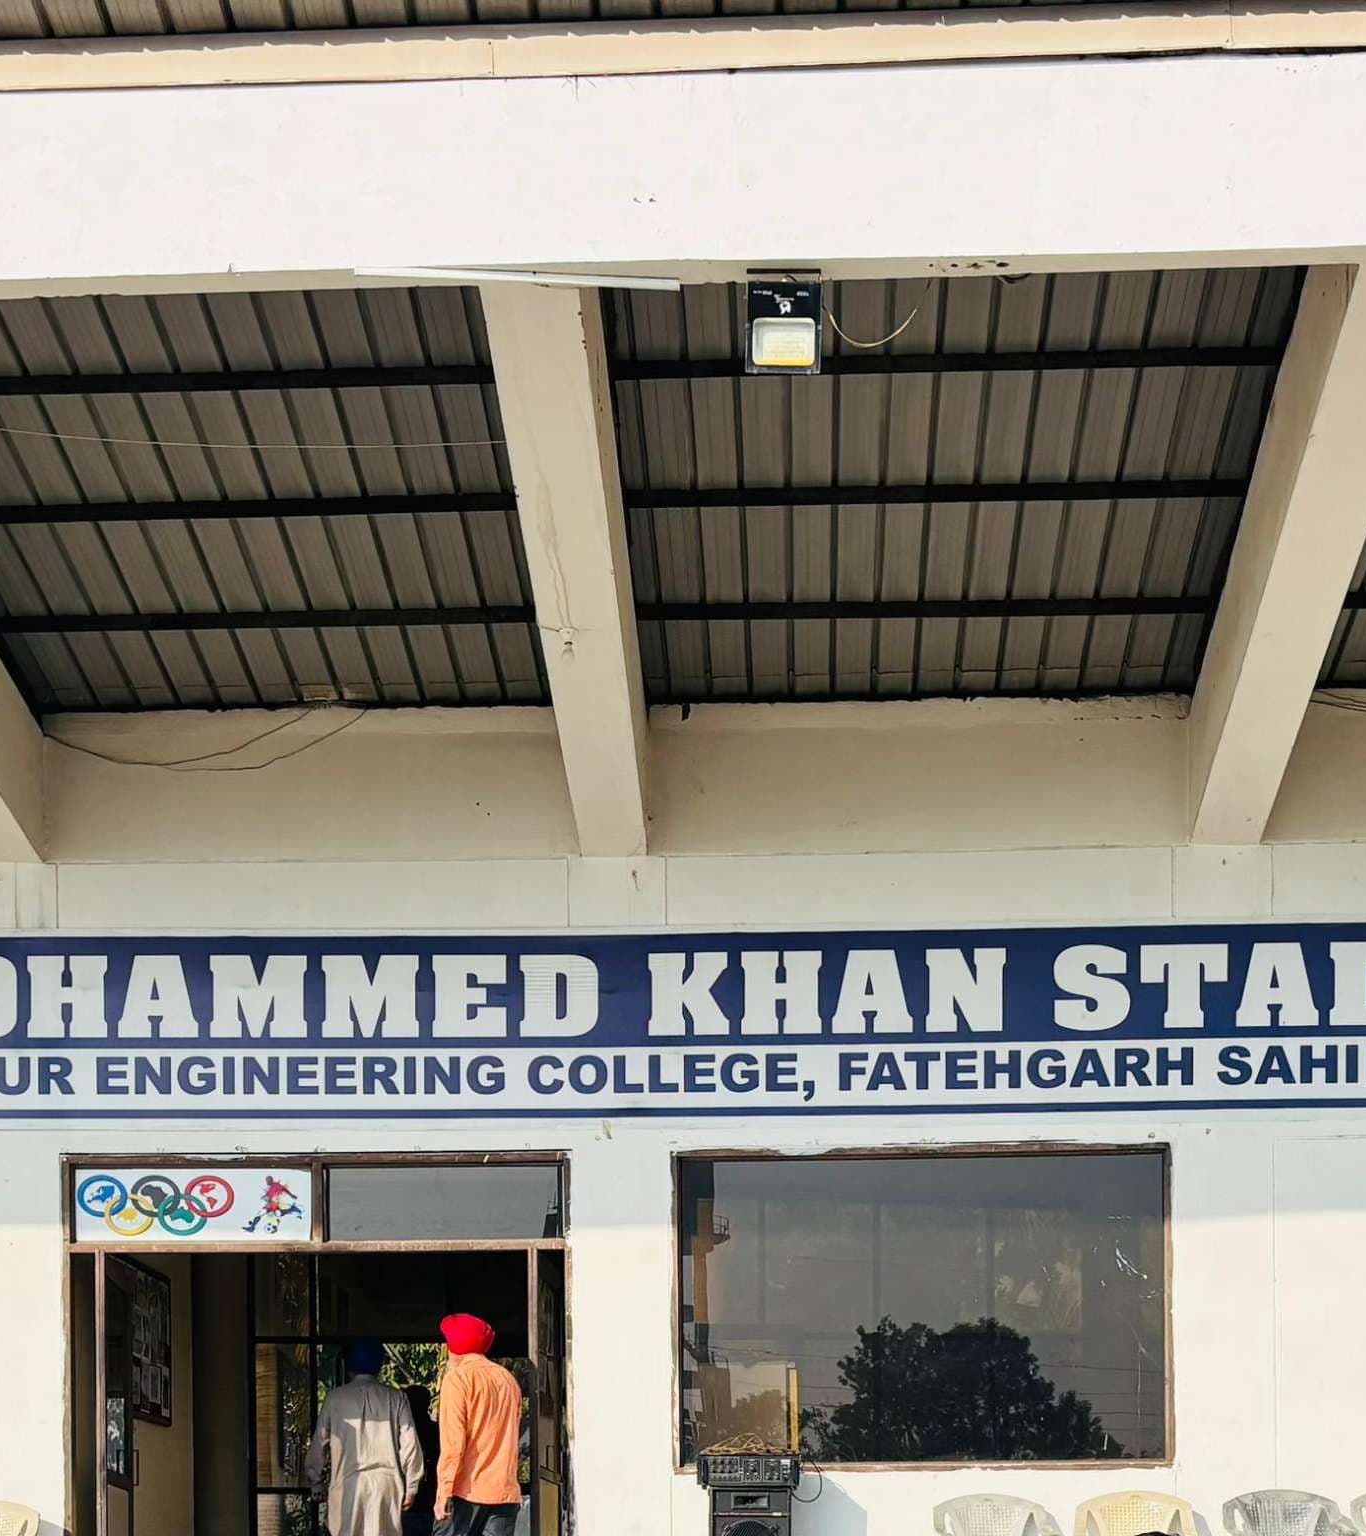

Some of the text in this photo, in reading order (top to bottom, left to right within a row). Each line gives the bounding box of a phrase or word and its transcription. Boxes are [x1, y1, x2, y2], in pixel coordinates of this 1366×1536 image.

[646, 946, 1007, 1037] KHAN
[95, 1053, 505, 1097] ENGINEERING
[526, 1051, 816, 1102] COLLEGE,
[837, 1046, 1195, 1092] FATEHGARH
